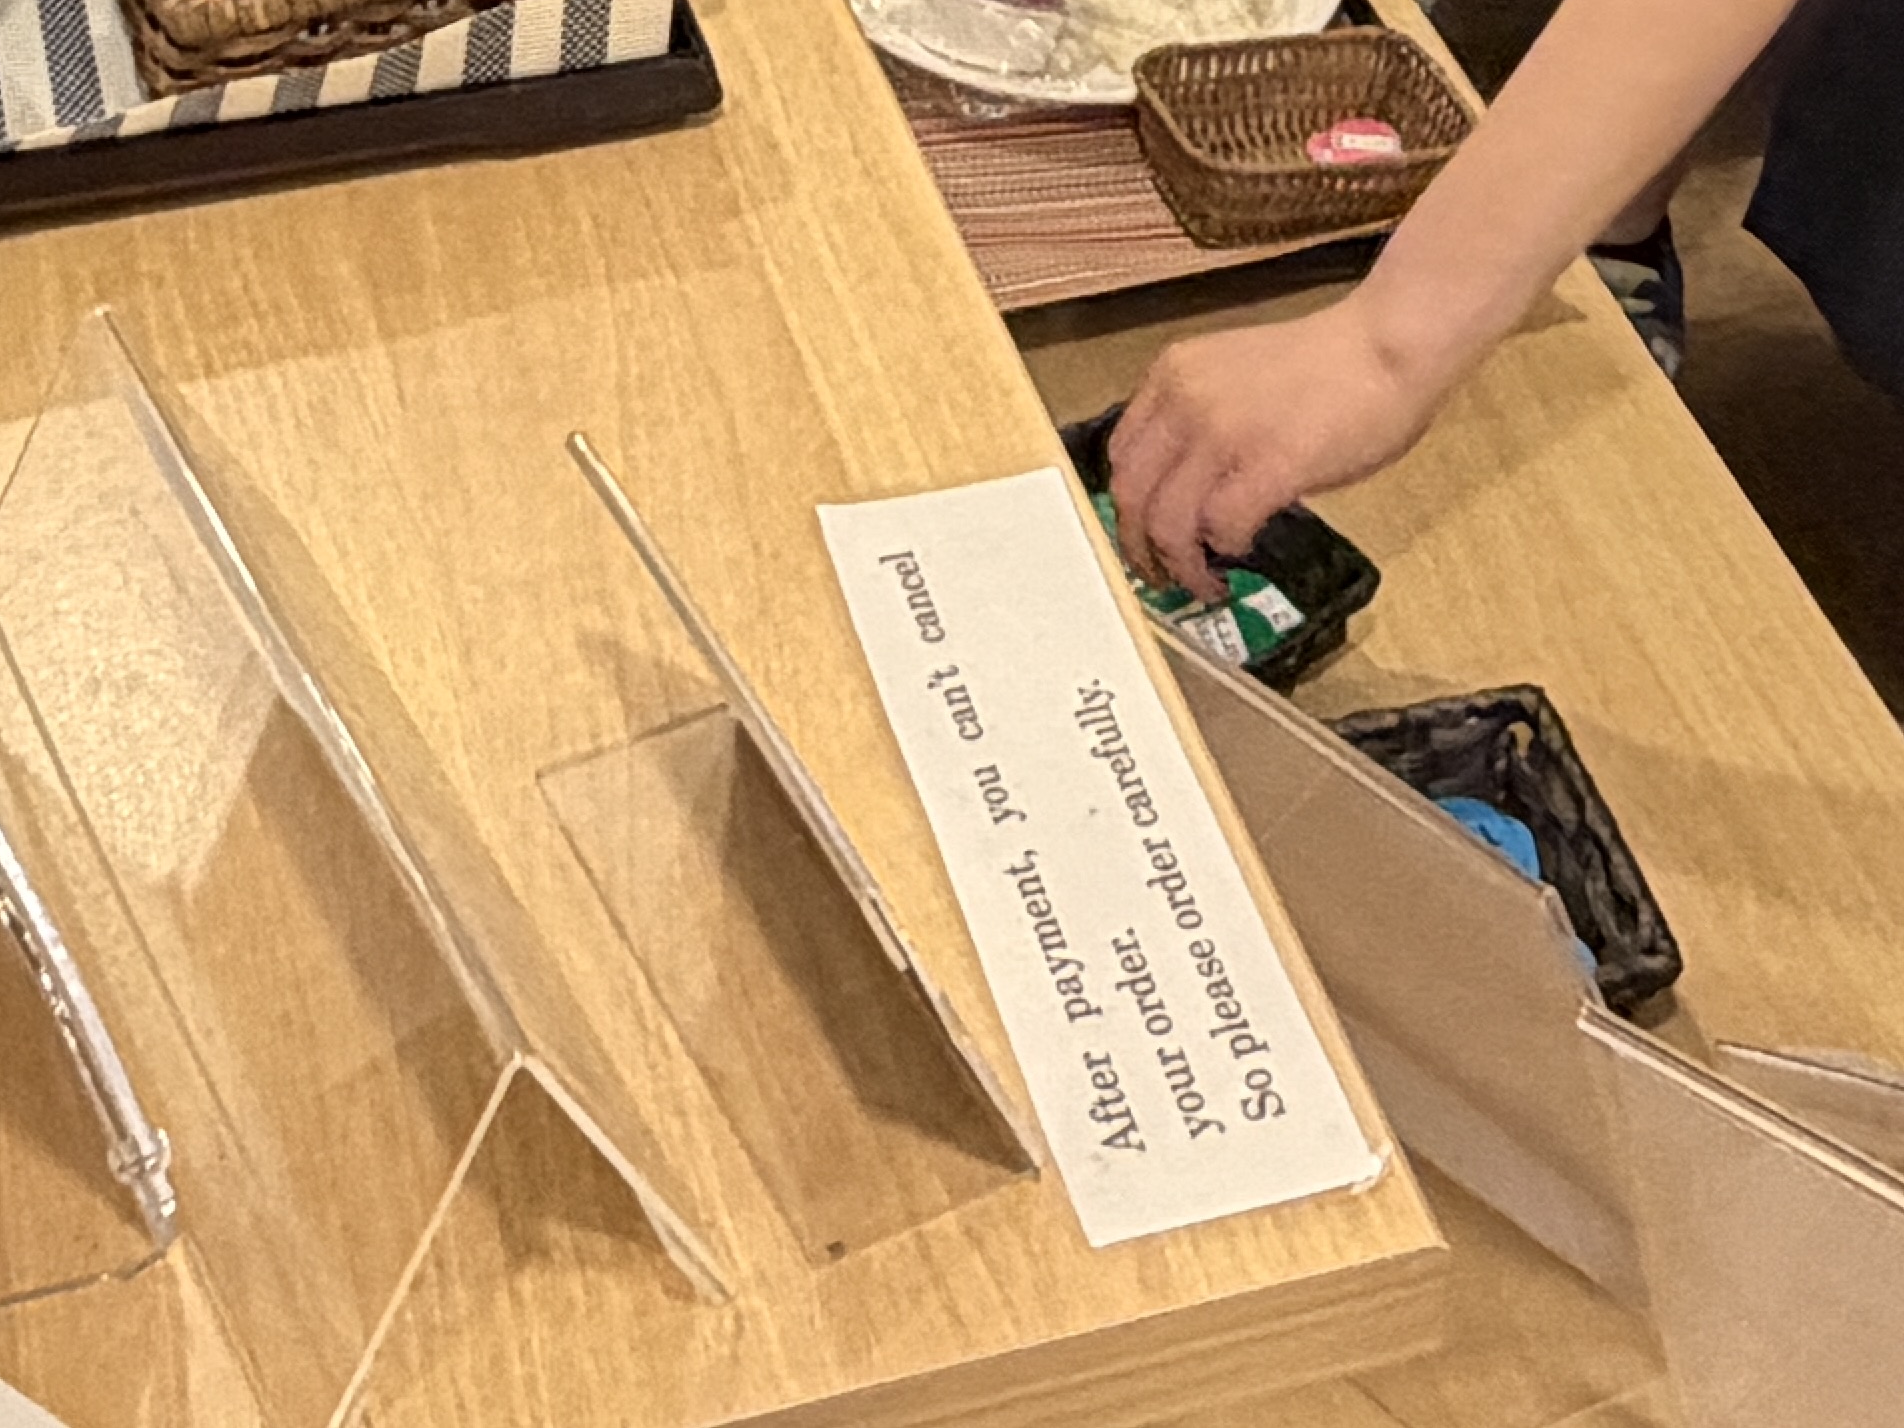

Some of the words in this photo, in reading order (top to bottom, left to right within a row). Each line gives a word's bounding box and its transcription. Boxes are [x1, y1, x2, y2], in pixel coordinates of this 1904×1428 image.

[878, 549, 947, 645] cancel
[926, 664, 985, 743] can't
[972, 763, 1028, 826] you
[1073, 678, 1160, 828] carefully.
[1142, 836, 1204, 931] order
[1002, 848, 1104, 1024] payment,
[1111, 926, 1174, 1037] order.
[1188, 937, 1271, 1061] please
[1083, 1050, 1146, 1153] After
[1156, 1045, 1226, 1140] your
[1240, 1067, 1287, 1123] So
